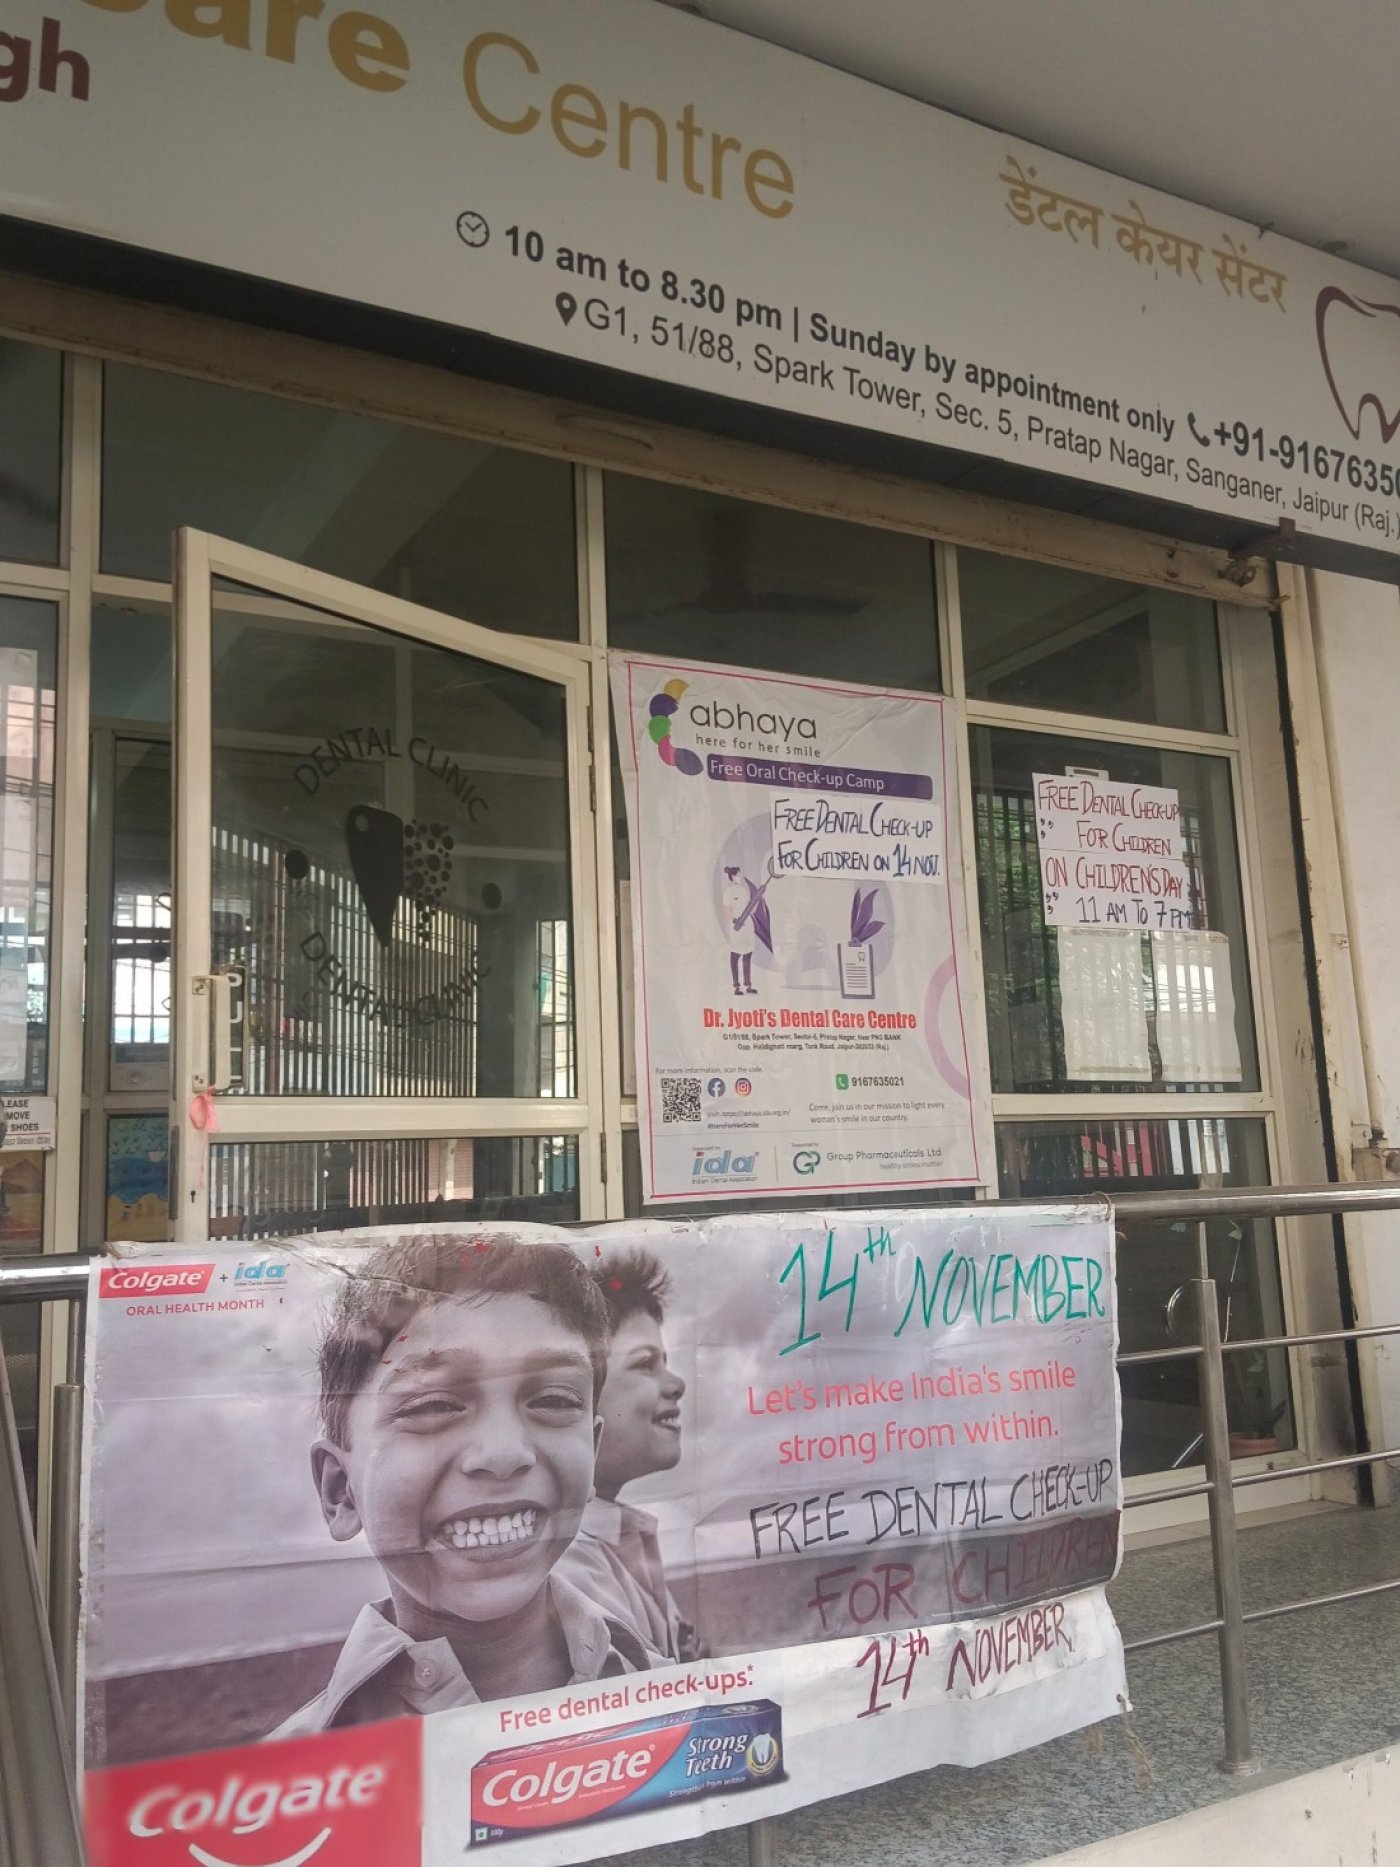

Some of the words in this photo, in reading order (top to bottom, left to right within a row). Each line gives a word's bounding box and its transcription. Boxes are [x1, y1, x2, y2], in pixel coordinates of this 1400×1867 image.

[81, 0, 410, 93] are
[462, 31, 795, 219] Centre
[998, 155, 1103, 249] डेंटल
[1111, 200, 1203, 285] केयर
[1213, 233, 1287, 314] सेंटर
[505, 225, 544, 263] 10
[556, 247, 607, 281] am
[618, 259, 650, 292] to
[661, 270, 725, 314] 8.30
[736, 298, 782, 330] pm
[810, 312, 916, 372] Sunday
[925, 345, 956, 383] by
[966, 363, 1120, 423] appointment
[1127, 408, 1175, 442] only
[585, 299, 639, 344] G1,
[651, 315, 741, 371] 51/88,
[754, 343, 835, 391] Spark
[843, 366, 925, 418] Tower,
[936, 392, 989, 430] Sec.
[998, 409, 1018, 441] 5,
[1028, 416, 1101, 463] Pratap
[1110, 437, 1178, 482] Nagar,
[1187, 458, 1286, 509] Sanganer,
[1293, 487, 1349, 522] Jaipur
[690, 701, 817, 742] abhaya
[696, 734, 726, 748] here
[733, 738, 752, 750] for
[759, 742, 780, 753] her
[786, 746, 821, 758] smile
[294, 727, 402, 796] DENTAL
[408, 737, 489, 823] CLINIC
[711, 760, 743, 776] Free
[747, 764, 775, 779] Oral
[779, 766, 843, 788] Check-up
[846, 770, 884, 791] Camp
[775, 799, 815, 832] FREE
[816, 800, 869, 834] DENTAL
[1038, 780, 1079, 811] FREE
[1081, 781, 1130, 817] DENTAL
[1077, 821, 1108, 848] FOR
[778, 840, 803, 870] FOR
[805, 838, 869, 871] CHILDREN
[874, 855, 890, 870] ON
[893, 844, 912, 877] 14
[1046, 856, 1069, 888] ON
[1076, 896, 1101, 923] 11
[1106, 902, 1128, 924] AM
[1154, 901, 1167, 929] 7
[1171, 908, 1193, 929] PM
[704, 1008, 725, 1028] Dr.
[728, 1008, 777, 1029] Jyoti's
[780, 1009, 830, 1028] Dental
[832, 1009, 865, 1028] Care
[868, 1010, 917, 1029] Centre
[851, 1077, 905, 1087] 9167635021
[6, 1111, 30, 1120] MOVE
[903, 1102, 910, 1110] to
[911, 1101, 926, 1110] light
[928, 1102, 945, 1110] every
[11, 1124, 39, 1132] SHOES
[827, 1152, 854, 1162] Group
[856, 1149, 925, 1160] Pharmaceuticals
[927, 1149, 942, 1158] Ltd
[108, 1271, 202, 1292] Colgate
[234, 1260, 286, 1281] ida
[894, 1248, 1105, 1338] NOVEMBER
[126, 1305, 162, 1317] ORAL
[165, 1303, 215, 1315] HEALTH
[218, 1299, 265, 1312] MONTH
[747, 1380, 816, 1416] Let's
[826, 1374, 904, 1408] make
[912, 1365, 1001, 1400] India's
[1009, 1360, 1077, 1393] smile
[779, 1432, 877, 1465] strong
[885, 1421, 956, 1453] from
[964, 1410, 1059, 1445] within.
[749, 1491, 849, 1559] FREE
[862, 1475, 1003, 1545] DENTAL
[1010, 1458, 1114, 1523] CHECK-UP
[807, 1562, 919, 1631] FOR
[952, 1509, 1122, 1605] CHILDREN
[500, 1708, 551, 1733] Free
[558, 1686, 630, 1721] dental
[686, 1751, 734, 1777] Teeth
[687, 1735, 749, 1758] Strong
[482, 1750, 652, 1806] Colgate
[127, 1761, 385, 1838] Colgate
